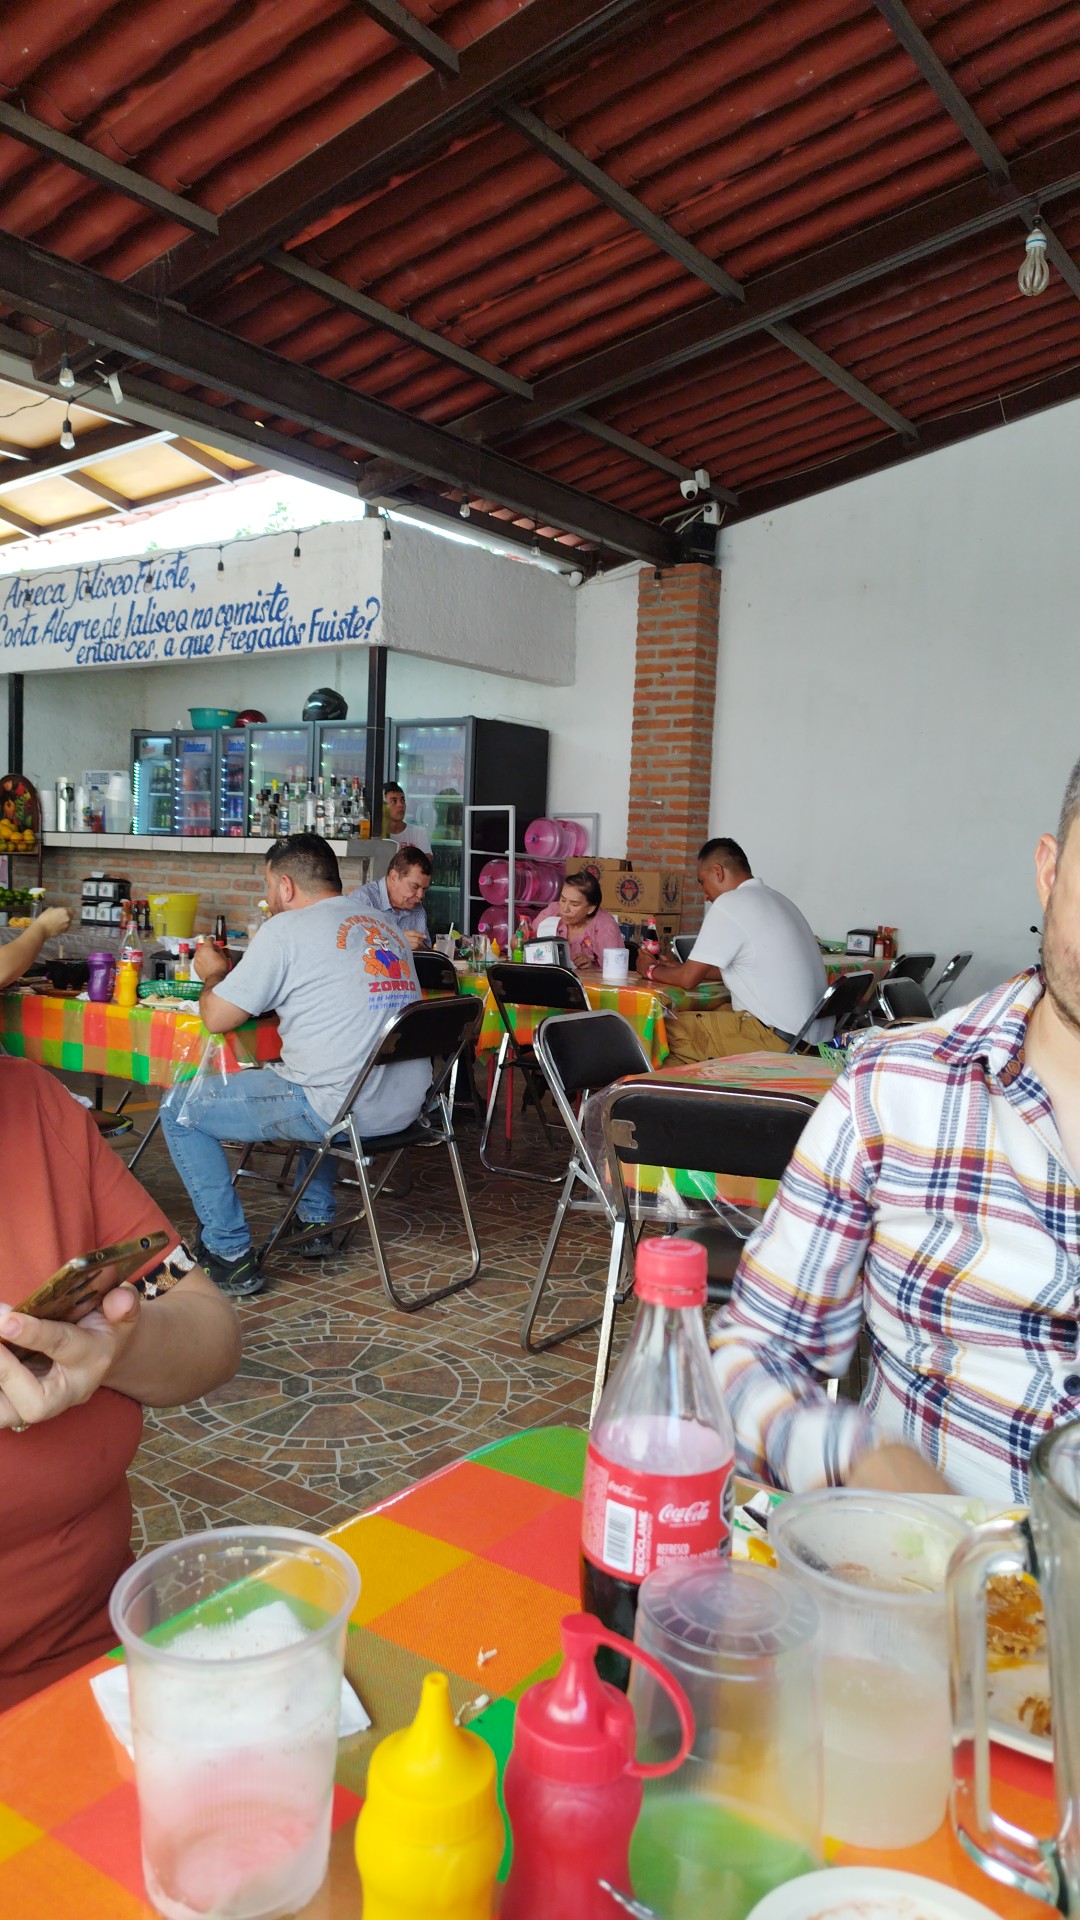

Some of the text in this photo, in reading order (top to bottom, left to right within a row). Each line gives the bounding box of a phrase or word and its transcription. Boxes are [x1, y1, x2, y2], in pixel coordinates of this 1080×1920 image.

[3, 577, 68, 611] Ameca
[63, 562, 133, 610] Jalisco
[0, 612, 40, 648] Costa
[42, 608, 101, 652] Alegre
[102, 602, 122, 640] de
[191, 606, 214, 630] no
[164, 637, 177, 656] a
[180, 633, 215, 660] que
[218, 618, 307, 653] Fregados
[309, 596, 381, 643] Fuiste?
[368, 981, 417, 993] ZORRO
[656, 1543, 690, 1555] REFRESCO
